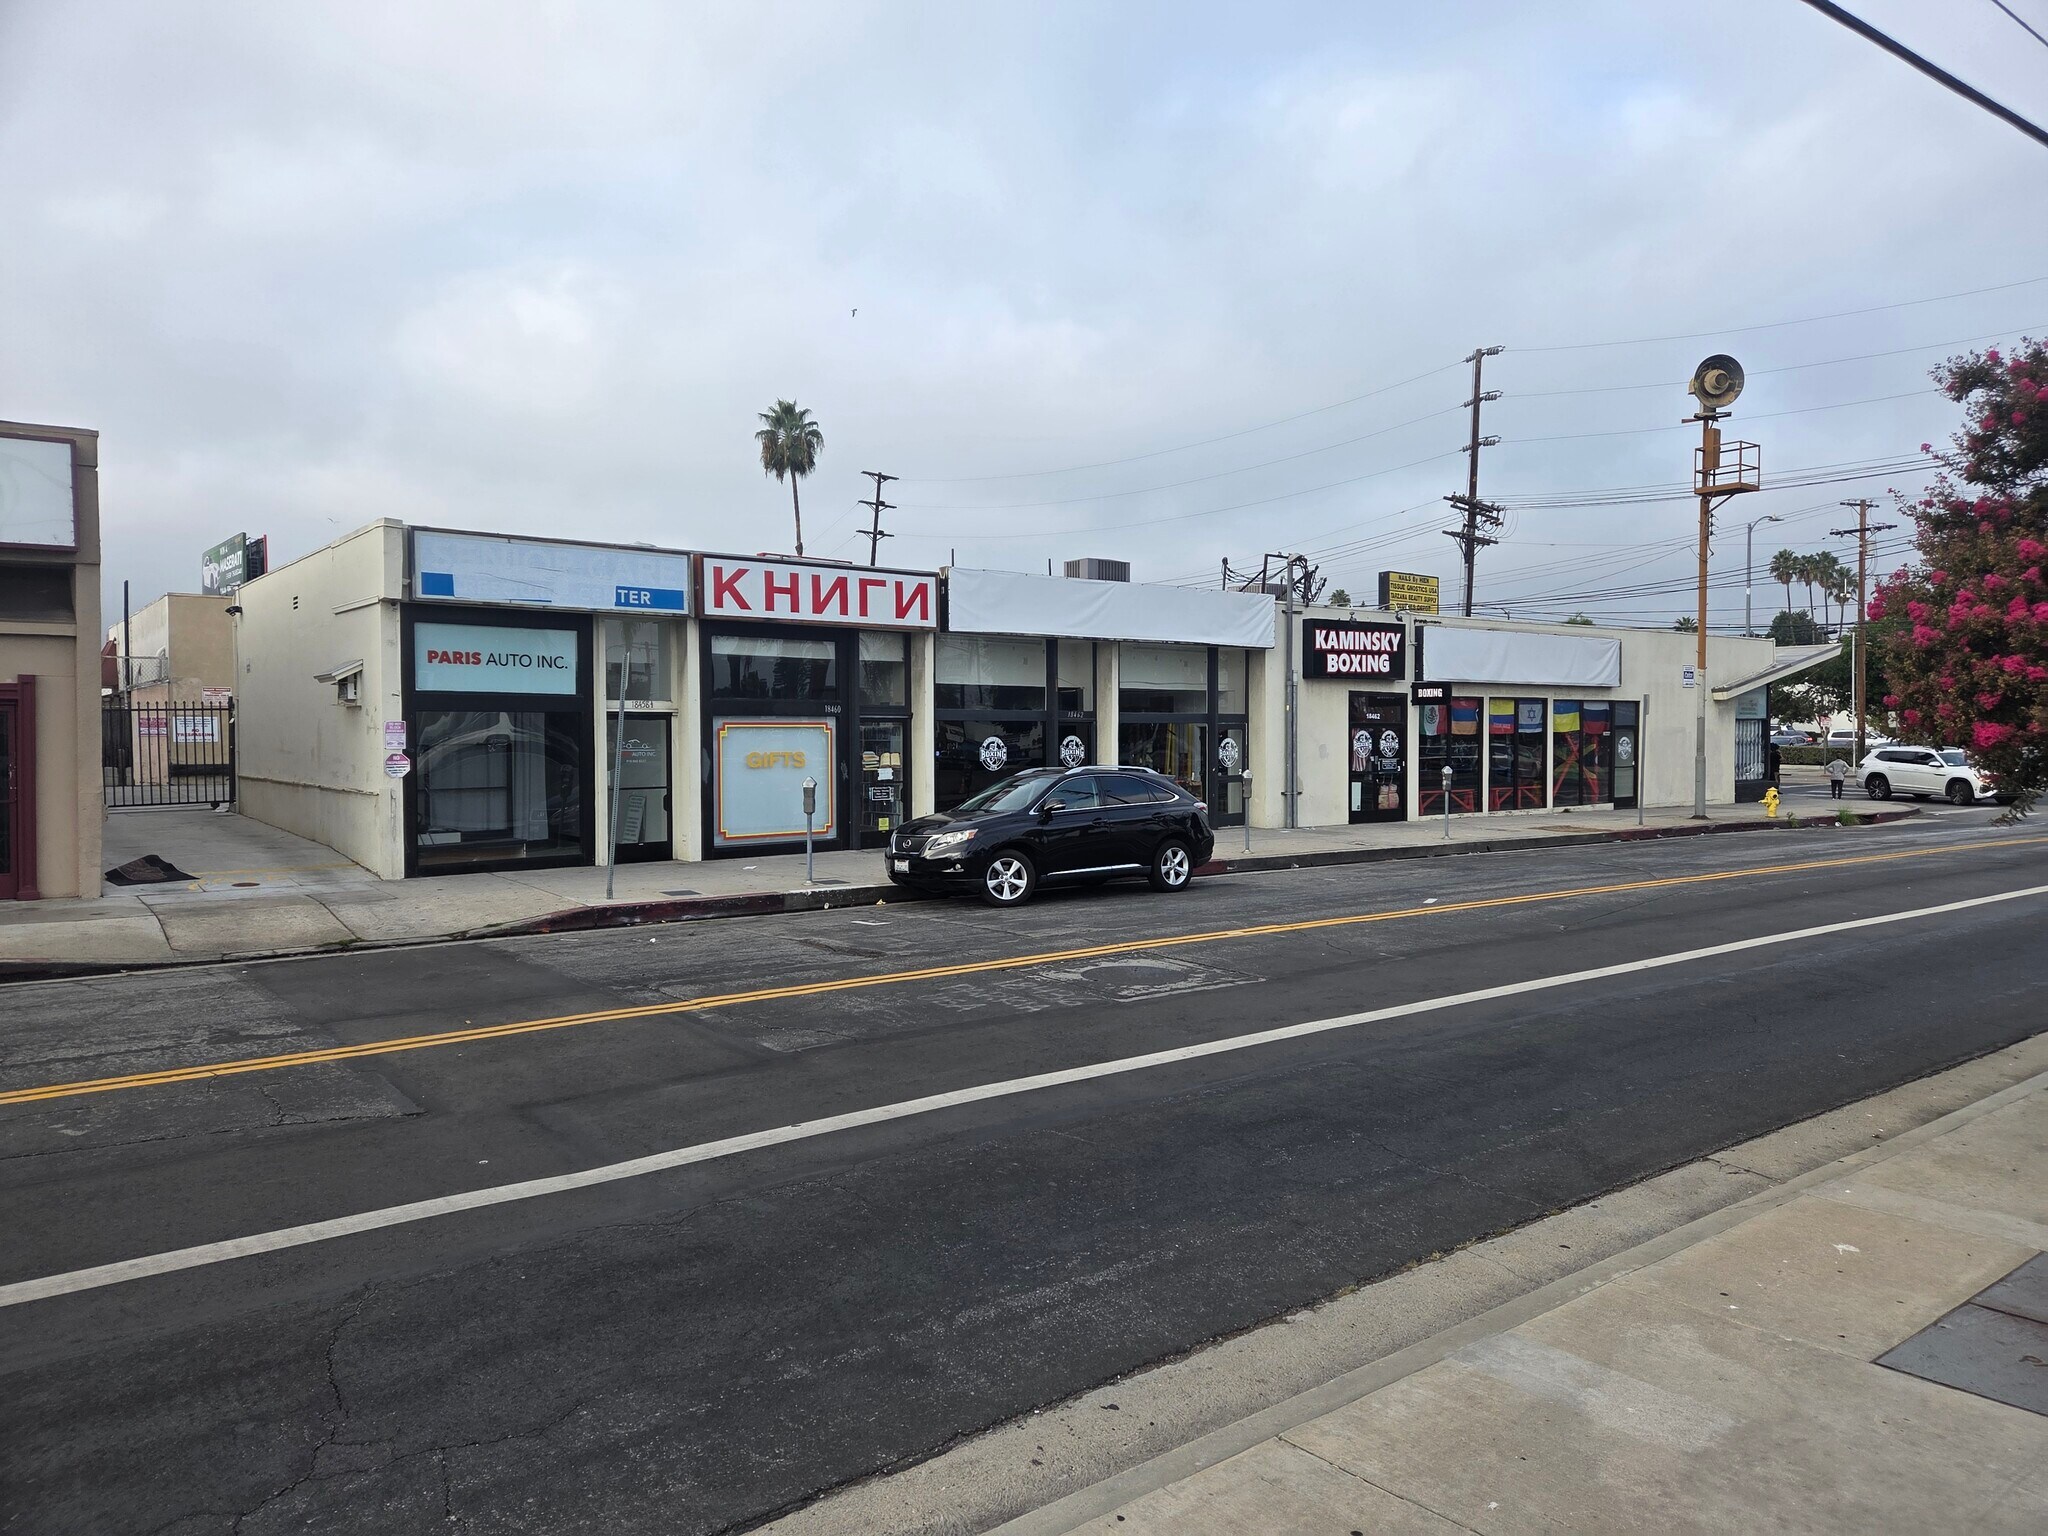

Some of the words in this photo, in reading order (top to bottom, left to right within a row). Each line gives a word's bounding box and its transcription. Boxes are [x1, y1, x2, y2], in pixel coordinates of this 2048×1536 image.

[220, 550, 242, 573] MASERATI
[1398, 574, 1411, 582] NAILS
[712, 565, 929, 621] КНИГИ
[1406, 584, 1428, 593] GNOSTICS
[617, 588, 651, 605] TER
[1390, 592, 1408, 600] TARZANA
[1408, 594, 1423, 602] BEAUTY
[1424, 596, 1437, 604] SUPPLY
[1315, 629, 1401, 652] KAMINSKY
[427, 650, 482, 666] PARIS
[486, 652, 532, 668] AUTO
[537, 655, 568, 669] INC.
[1326, 653, 1390, 673] BOXING
[1418, 688, 1443, 698] BOXING
[824, 704, 841, 714] 18460
[746, 751, 806, 769] GIFTS
[980, 749, 1007, 759] BOXING
[1061, 748, 1085, 759] BOXING
